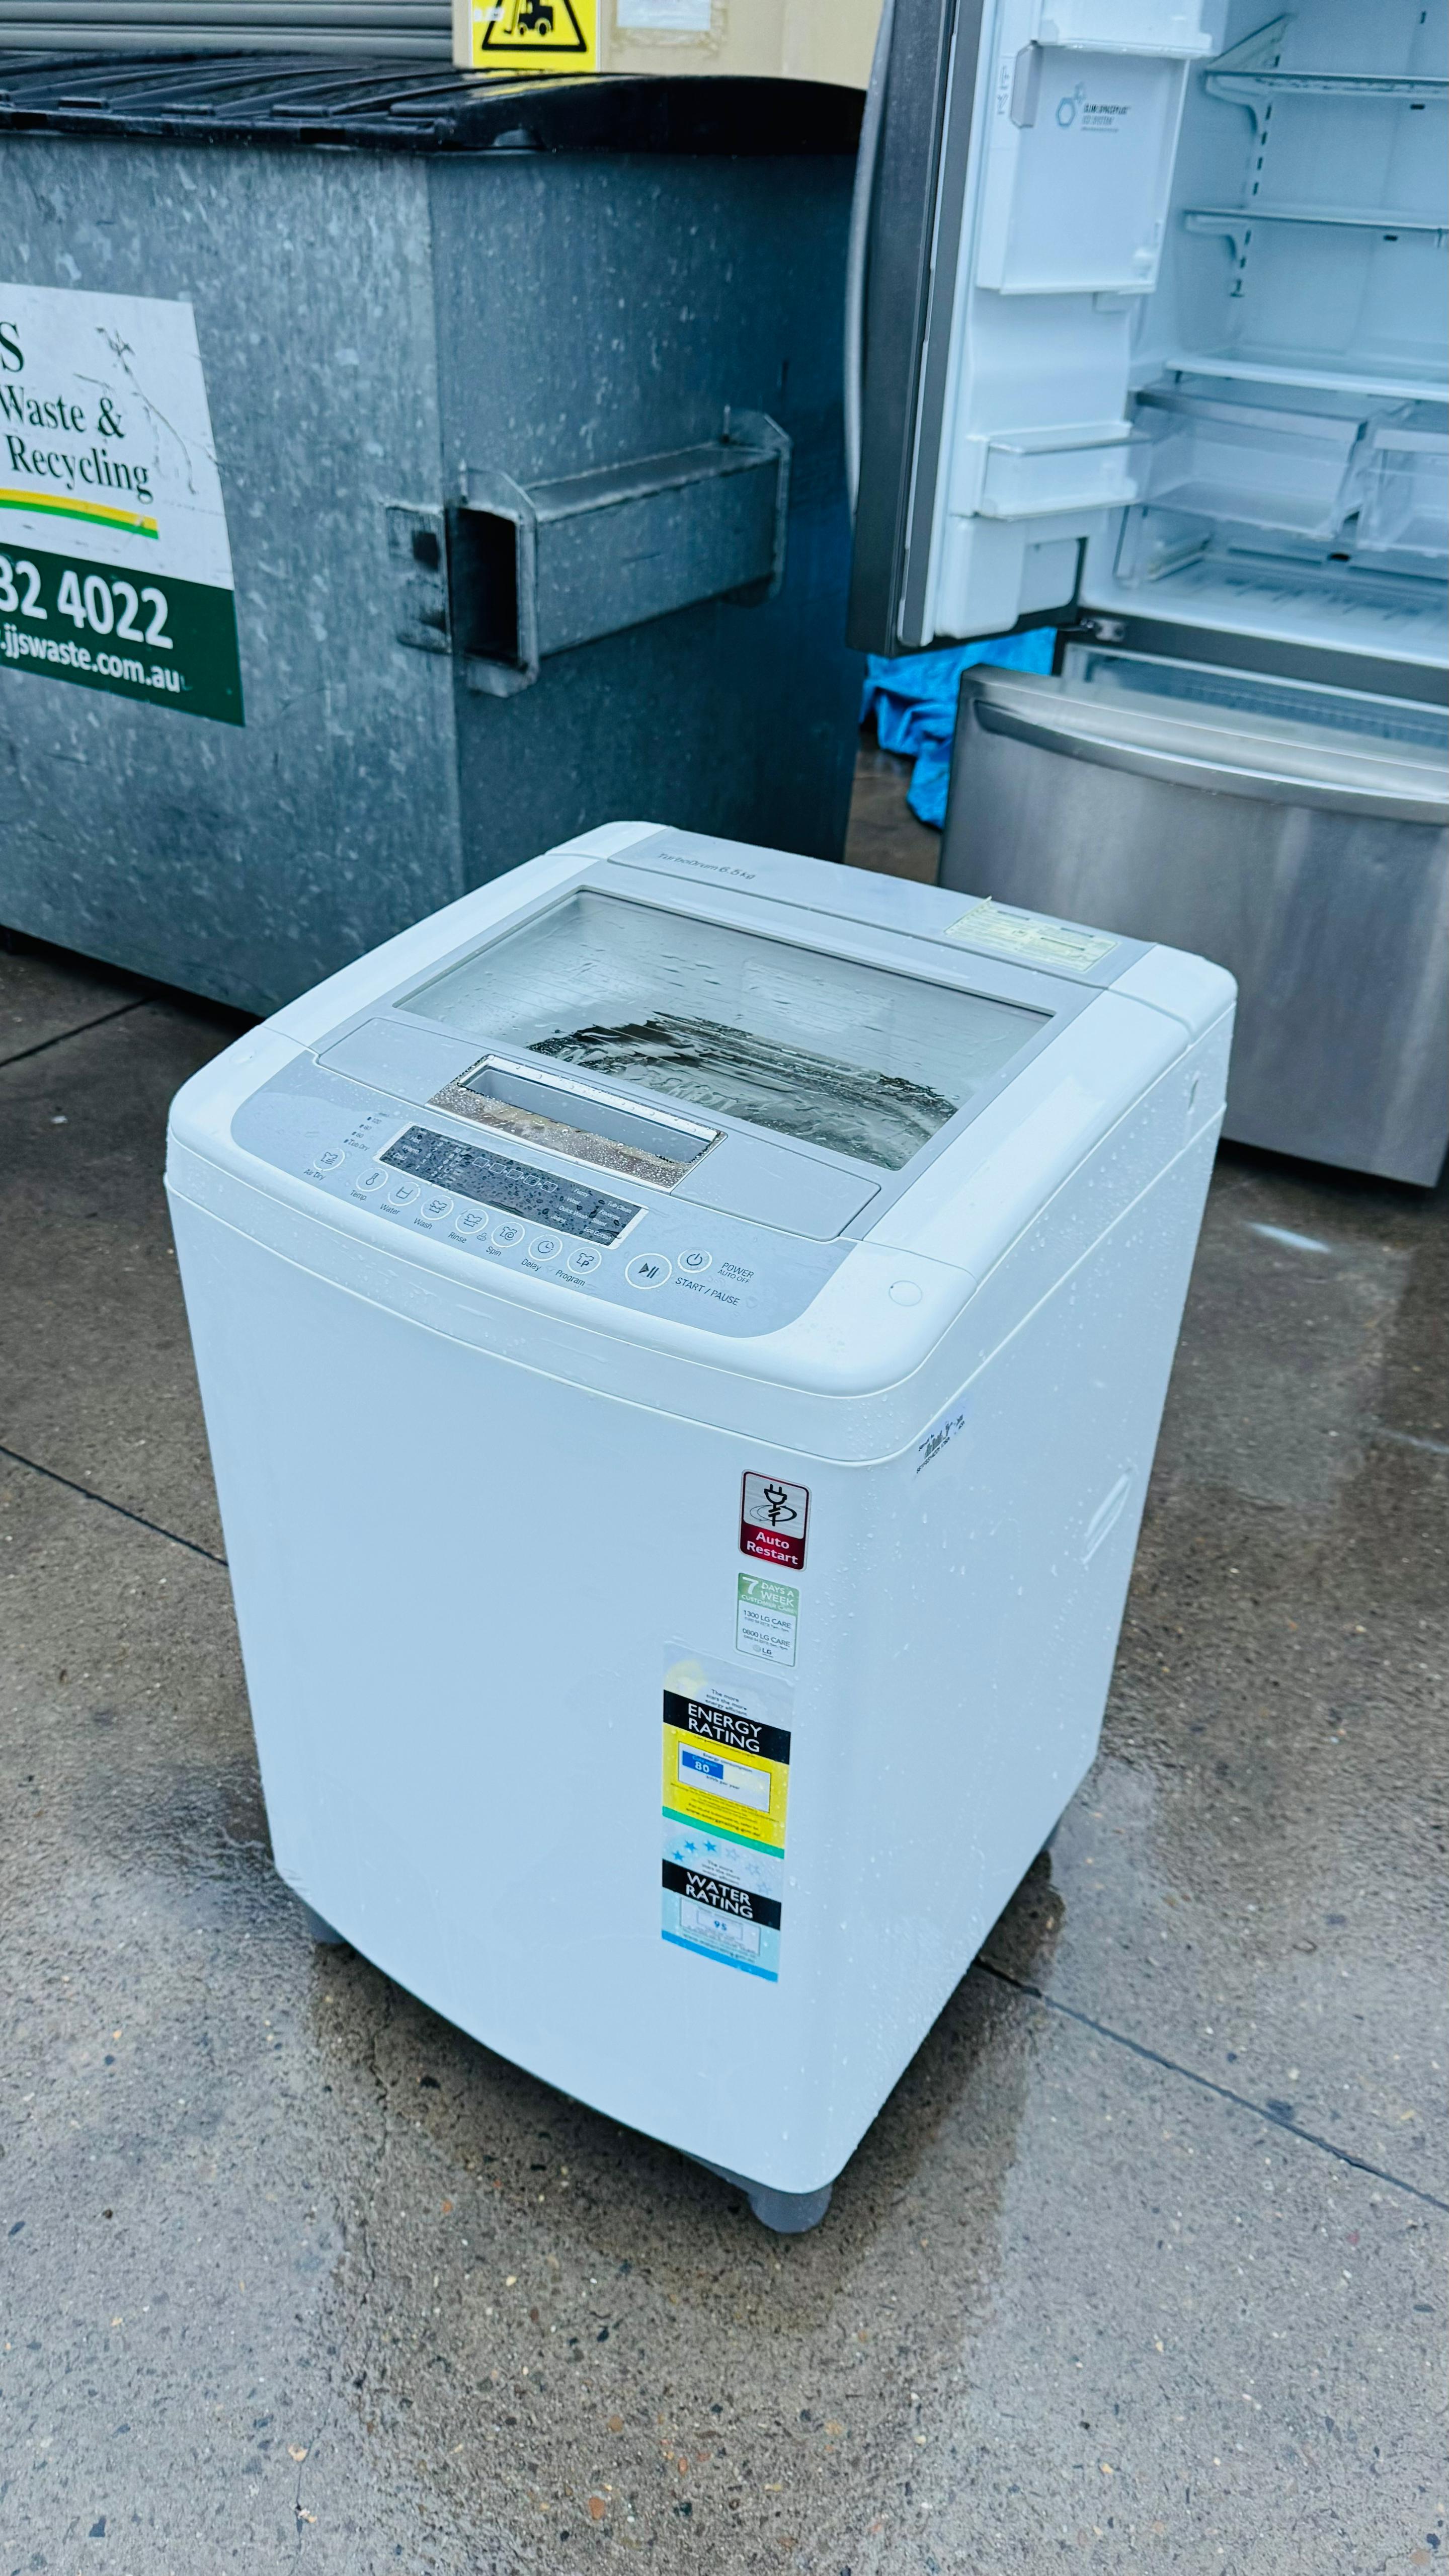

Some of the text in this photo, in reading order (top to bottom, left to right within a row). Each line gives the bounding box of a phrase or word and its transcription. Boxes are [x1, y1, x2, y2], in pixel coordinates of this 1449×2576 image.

[0, 321, 24, 372] S
[0, 384, 125, 438] Waste &
[6, 435, 153, 504] Recycling
[57, 571, 173, 649] 4022
[359, 1143, 370, 1151] Dry
[313, 1171, 326, 1180] Dry
[574, 1188, 589, 1197] Fuzzy
[380, 1203, 401, 1215] Water
[558, 1205, 588, 1220] Quick Wash
[617, 1205, 632, 1214] Clean
[414, 1218, 433, 1229] Wash
[591, 1218, 607, 1227] Silent
[448, 1232, 467, 1243] Rinse
[593, 1230, 612, 1241] Cotton
[486, 1246, 502, 1257] Spin
[521, 1258, 541, 1271] Delay
[721, 1262, 754, 1278] POWER
[555, 1269, 585, 1286] Program
[717, 1269, 751, 1283] AUTO OFF
[675, 1277, 705, 1292] START
[710, 1290, 740, 1306] PAUSE
[756, 1532, 789, 1549] Auto
[747, 1540, 798, 1565] Restart
[742, 1576, 759, 1594] 7
[761, 1582, 785, 1594] DAYS
[761, 1590, 794, 1607] WEEK
[743, 1609, 759, 1619] 1300
[771, 1618, 791, 1629] CARE
[771, 1636, 790, 1647] CARE
[710, 1688, 722, 1698] The
[688, 1703, 762, 1738] ENERGY
[689, 1717, 760, 1752] RATING
[695, 1761, 710, 1773] 80
[687, 1871, 751, 1906] WATER
[686, 1884, 753, 1919] RATING
[713, 1919, 728, 1931] 95
